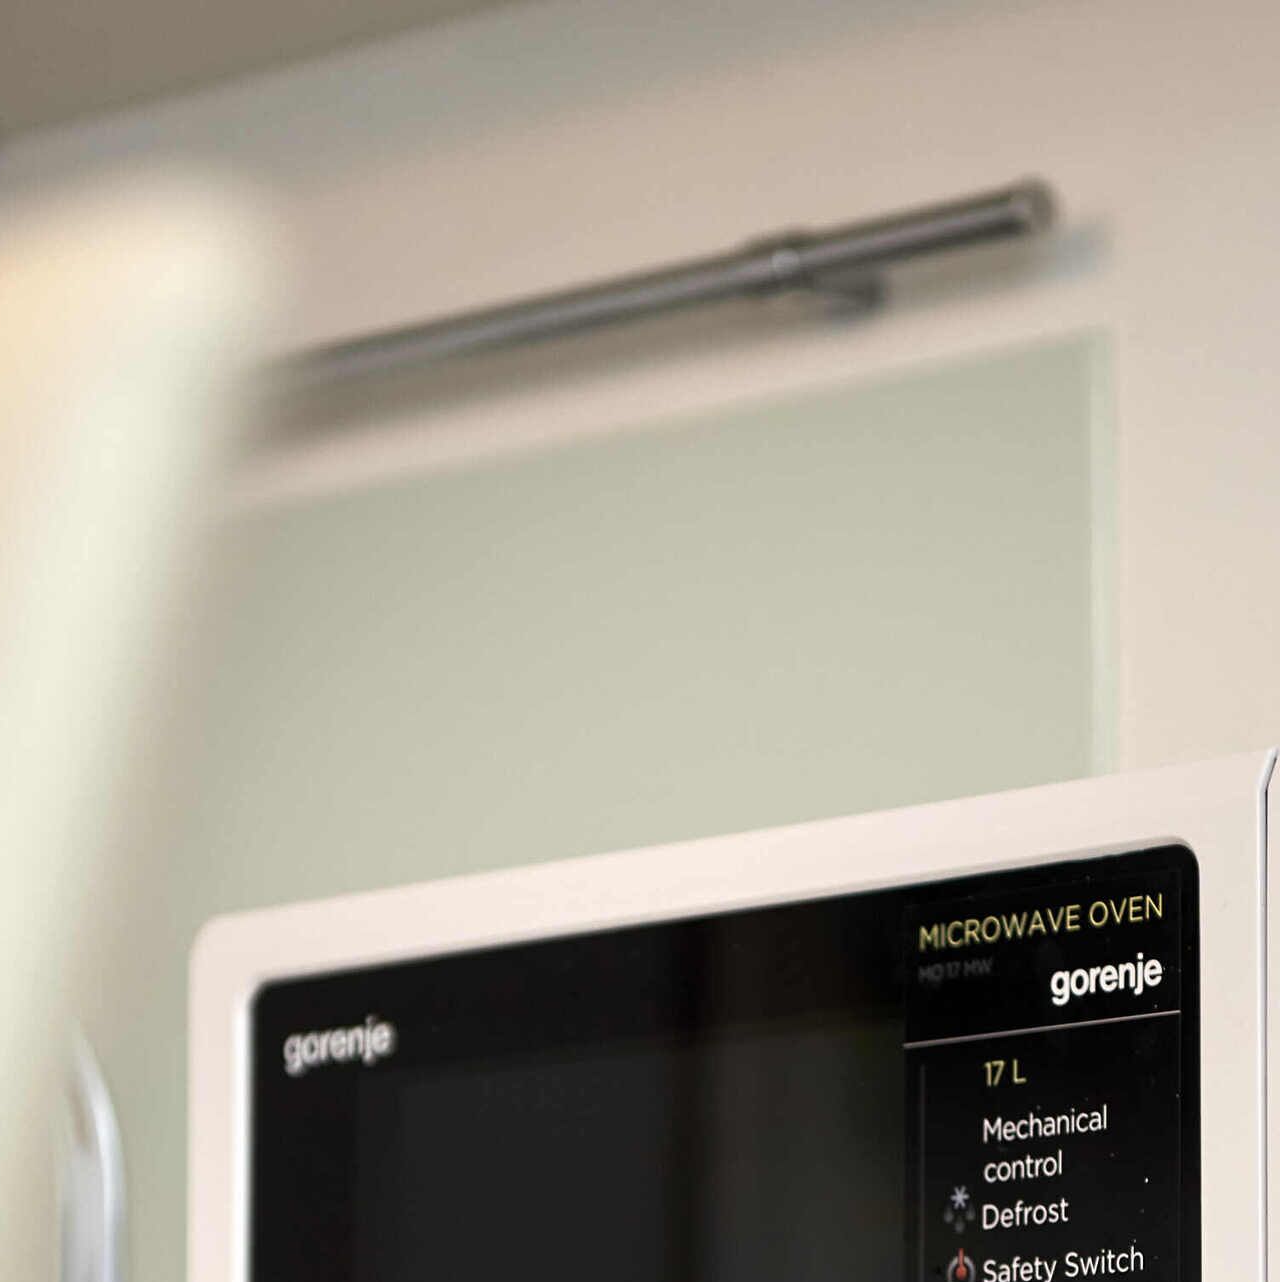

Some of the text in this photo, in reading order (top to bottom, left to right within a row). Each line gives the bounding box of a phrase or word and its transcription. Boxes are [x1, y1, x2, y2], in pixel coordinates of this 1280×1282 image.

[919, 893, 1163, 951] MICROWAVE OVEN
[1050, 952, 1164, 1006] gorenje
[283, 1014, 394, 1077] gorenje
[984, 1059, 1027, 1087] 17 L
[982, 1103, 1108, 1144] Mechanical
[984, 1149, 1063, 1183] control
[982, 1197, 1070, 1230] Defrost
[1064, 1245, 1144, 1278] Switch
